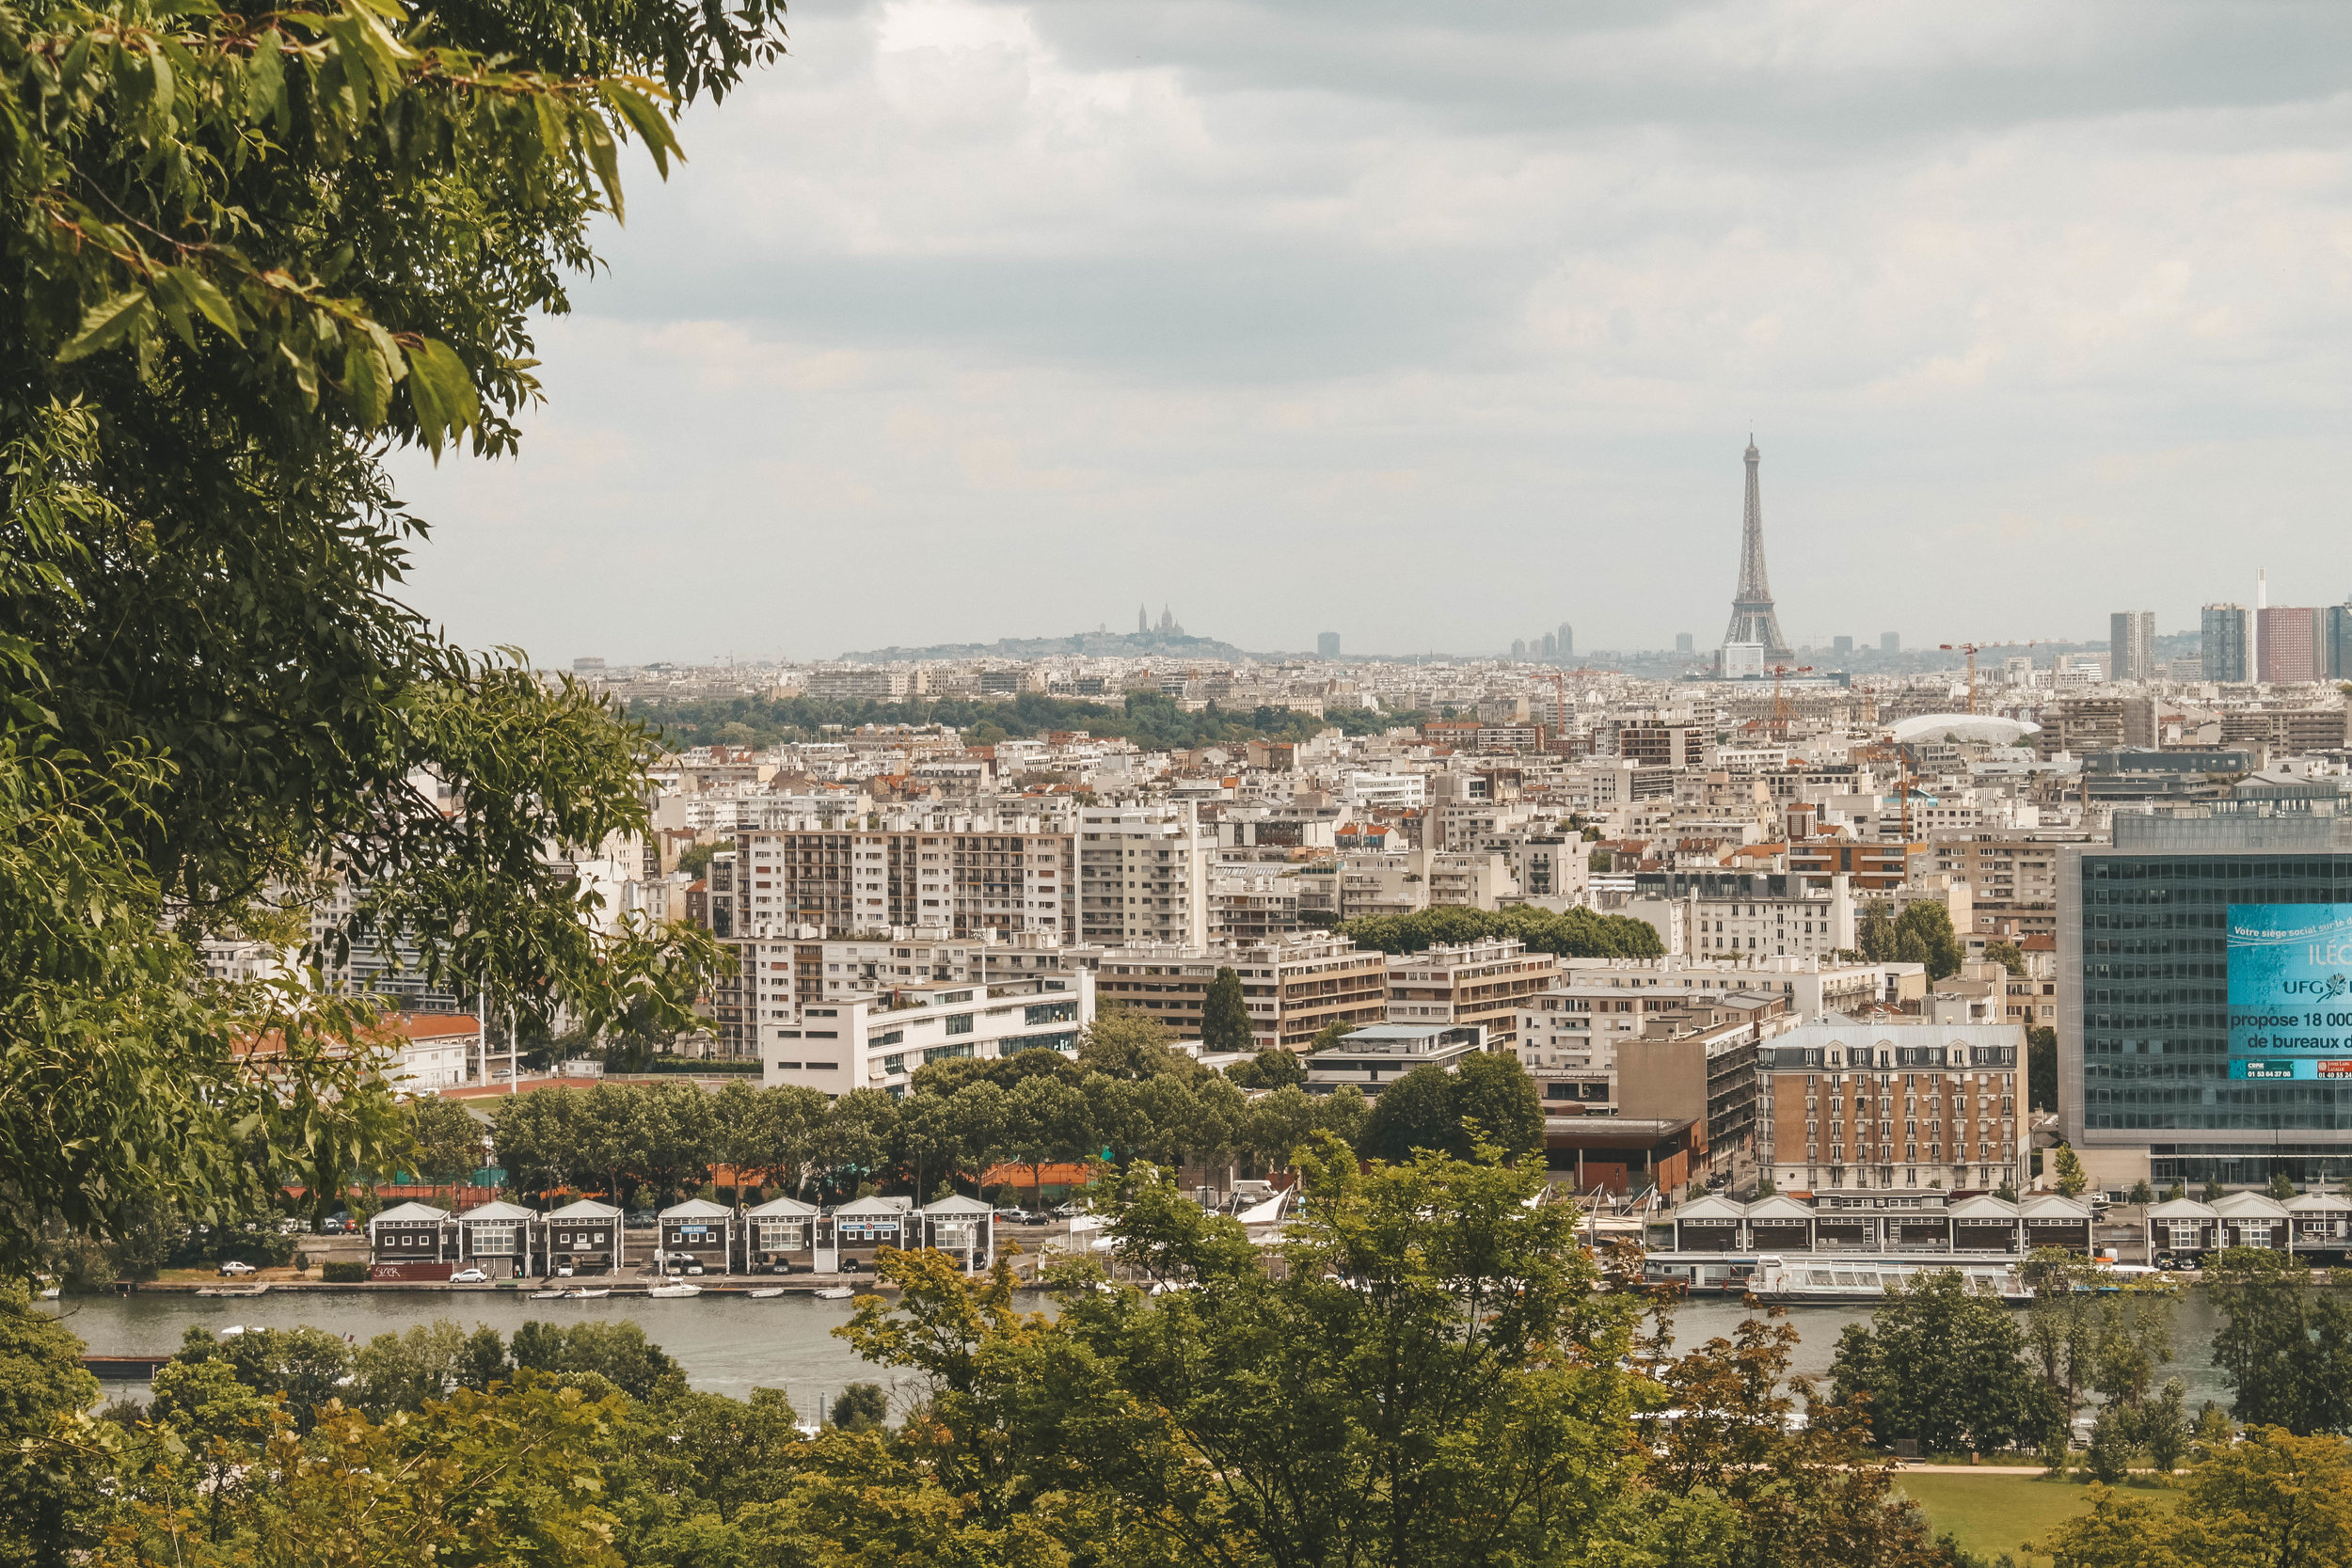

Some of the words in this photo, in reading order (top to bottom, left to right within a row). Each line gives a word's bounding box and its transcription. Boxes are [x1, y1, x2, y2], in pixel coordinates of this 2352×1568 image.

[2234, 926, 2260, 937] Votre
[2261, 928, 2287, 939] siège
[2288, 926, 2316, 937] social
[2318, 923, 2334, 932] sur
[2334, 919, 2344, 927] le
[2283, 980, 2324, 994] UFG
[2231, 1015, 2298, 1030] propose
[2303, 1012, 2322, 1026] 18
[2248, 1035, 2268, 1049] de
[2272, 1035, 2340, 1049] bureaux
